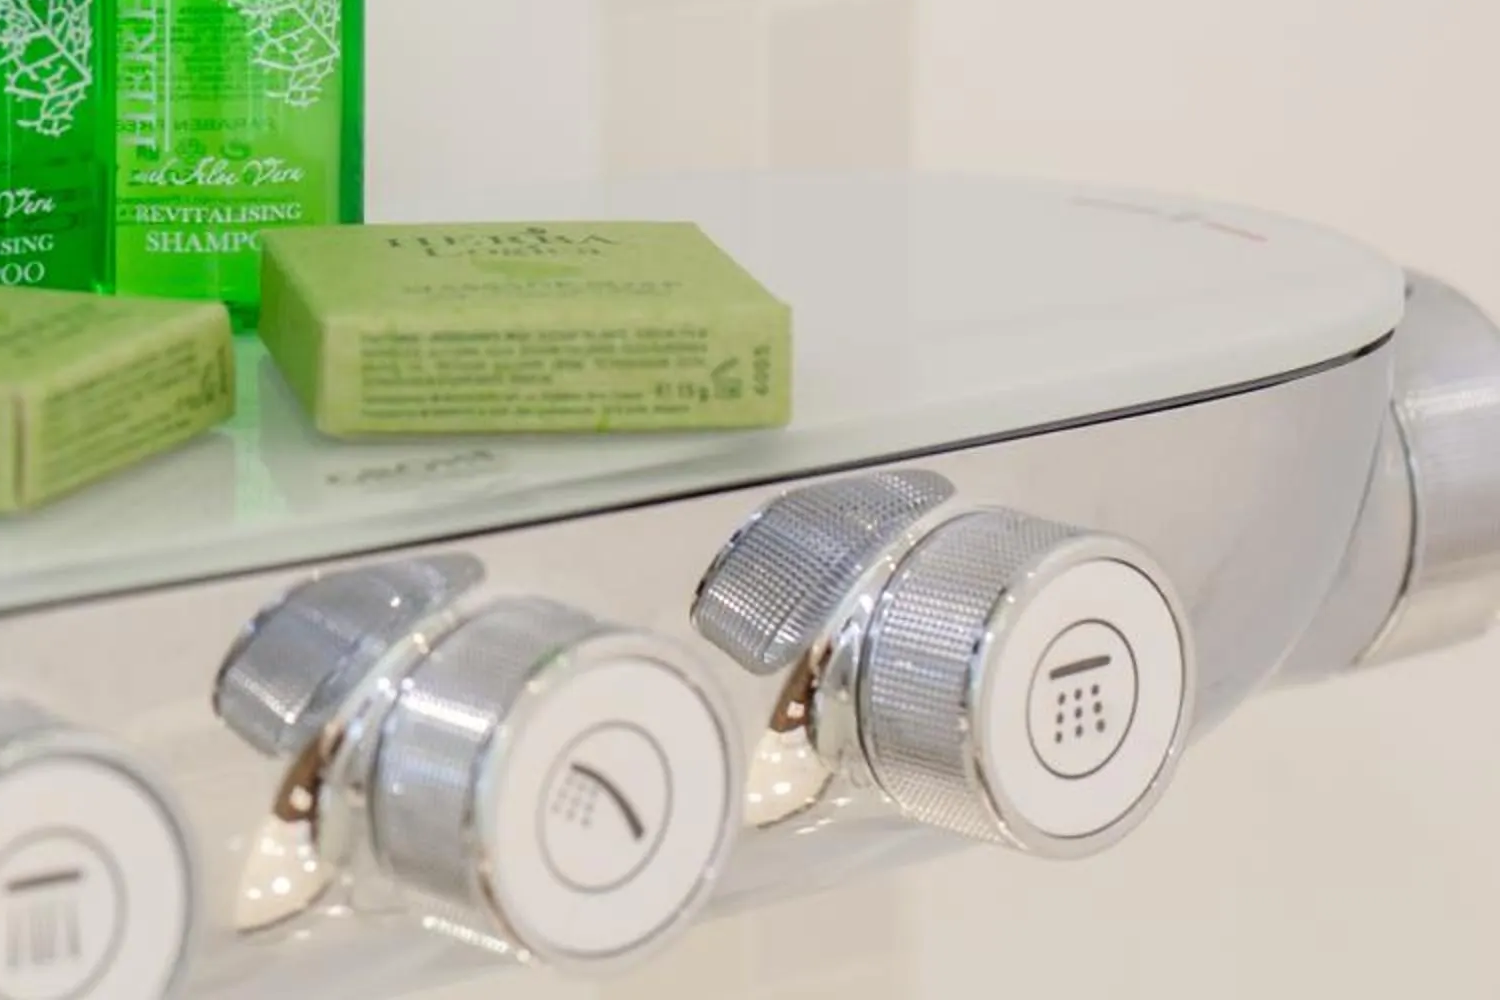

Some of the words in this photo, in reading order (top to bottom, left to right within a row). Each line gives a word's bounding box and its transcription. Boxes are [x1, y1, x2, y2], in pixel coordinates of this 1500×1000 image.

[242, 157, 304, 187] Vera
[135, 202, 304, 224] REVITALISING
[145, 229, 264, 254] SHAMPO
